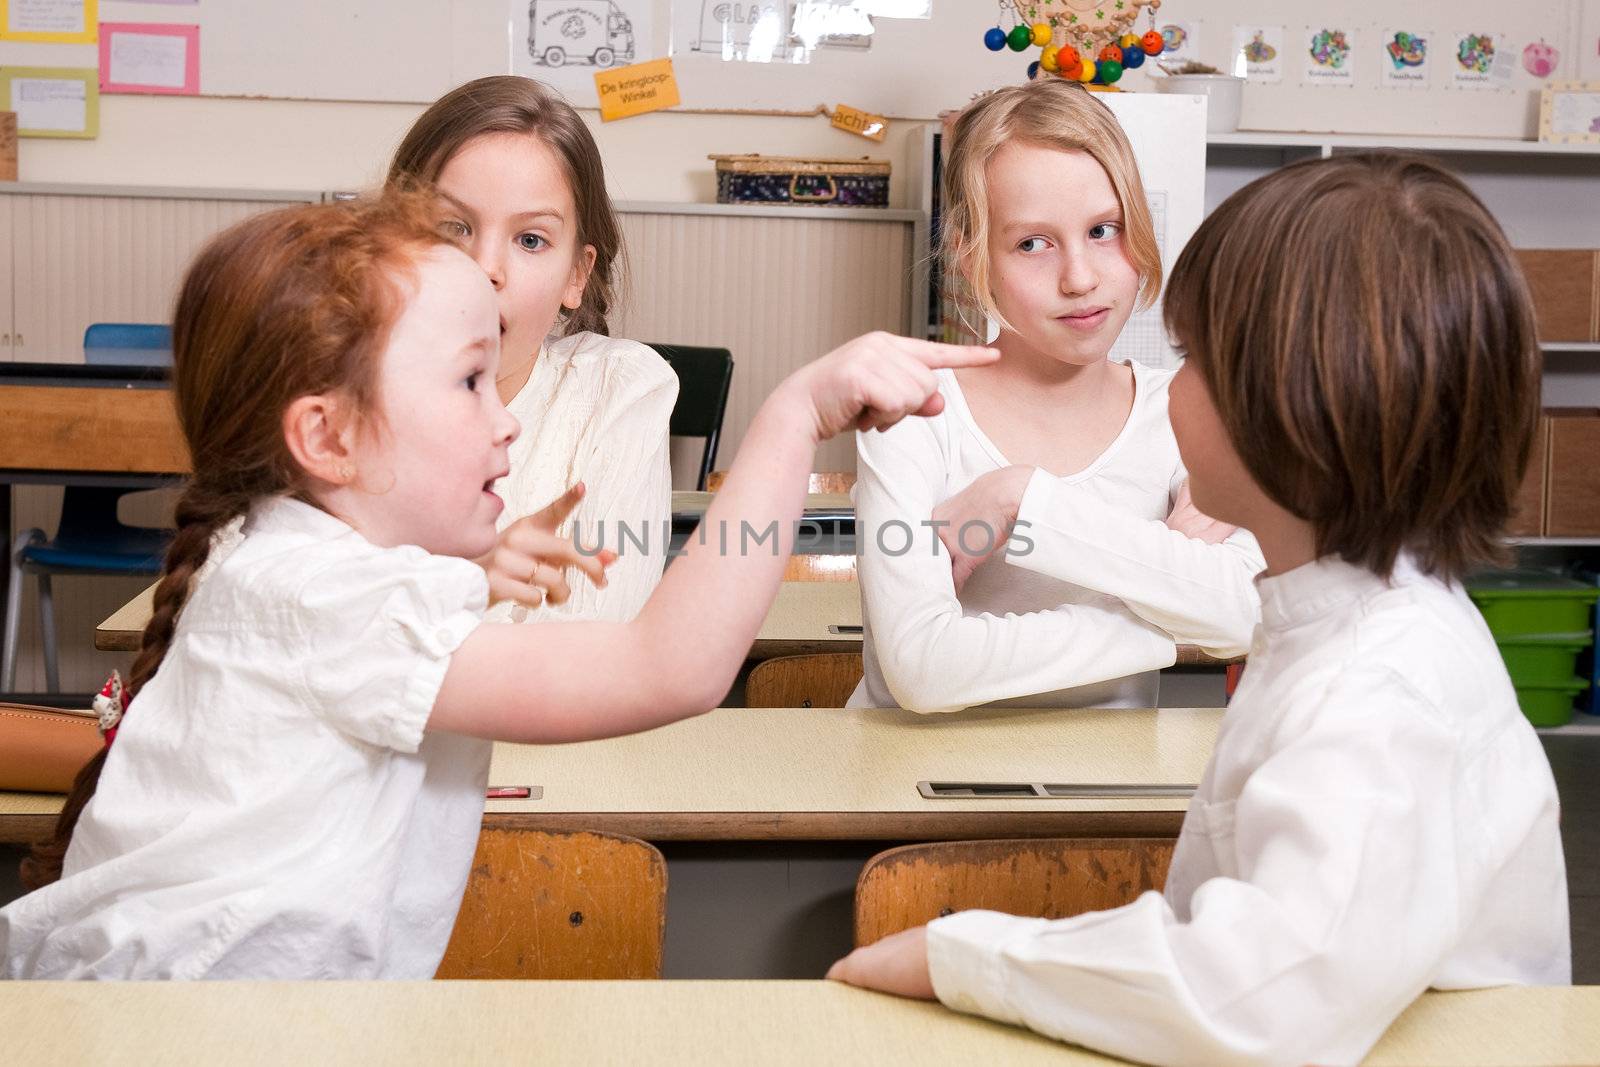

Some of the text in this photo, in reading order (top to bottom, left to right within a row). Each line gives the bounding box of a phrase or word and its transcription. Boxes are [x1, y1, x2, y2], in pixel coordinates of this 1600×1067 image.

[712, 3, 771, 24] GLA
[600, 84, 617, 95] De
[621, 87, 657, 104] Winkel
